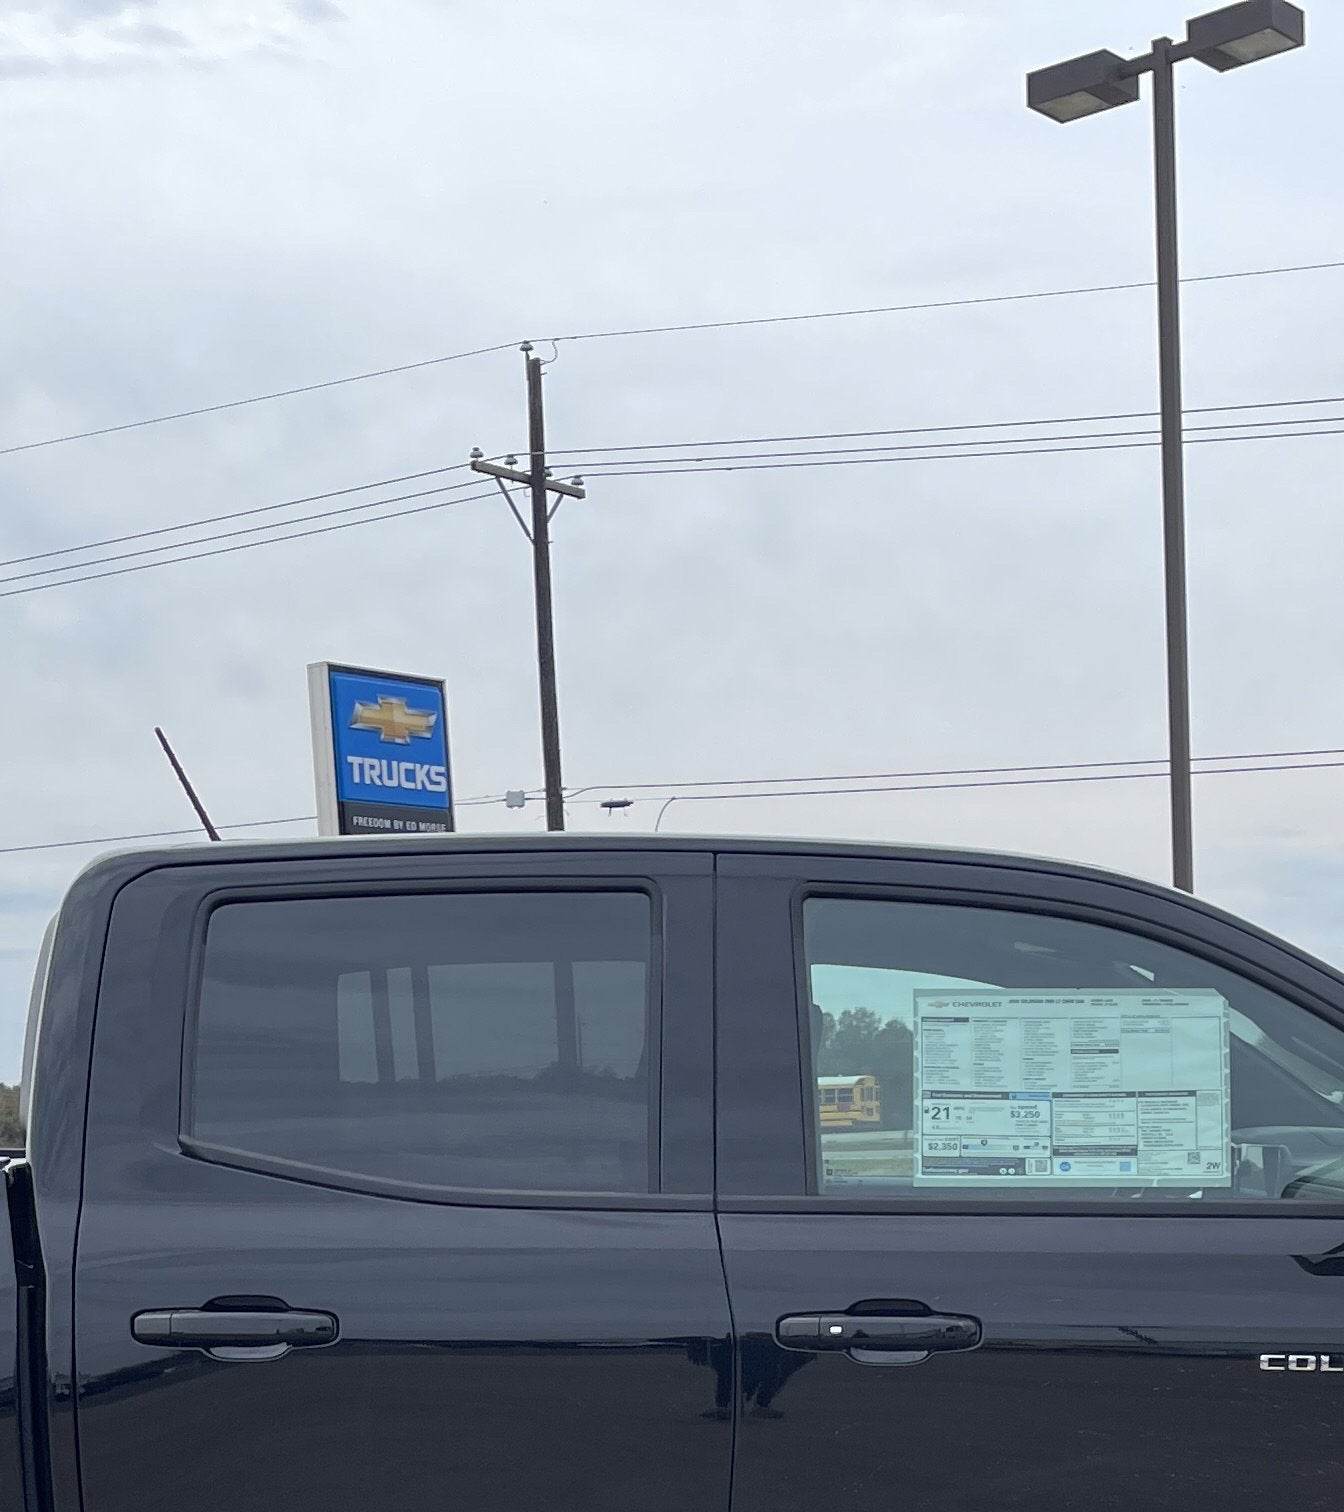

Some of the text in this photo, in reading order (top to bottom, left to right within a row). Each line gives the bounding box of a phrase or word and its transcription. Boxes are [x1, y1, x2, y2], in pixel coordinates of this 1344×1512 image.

[347, 756, 447, 792] TRUCKS
[353, 816, 391, 829] FREEDOM
[393, 819, 404, 830] BY
[406, 820, 417, 831] ED
[931, 1106, 950, 1120] 21
[1010, 1110, 1041, 1119] $3,250
[928, 1142, 958, 1151] $2,350
[1206, 1162, 1221, 1170] 2W
